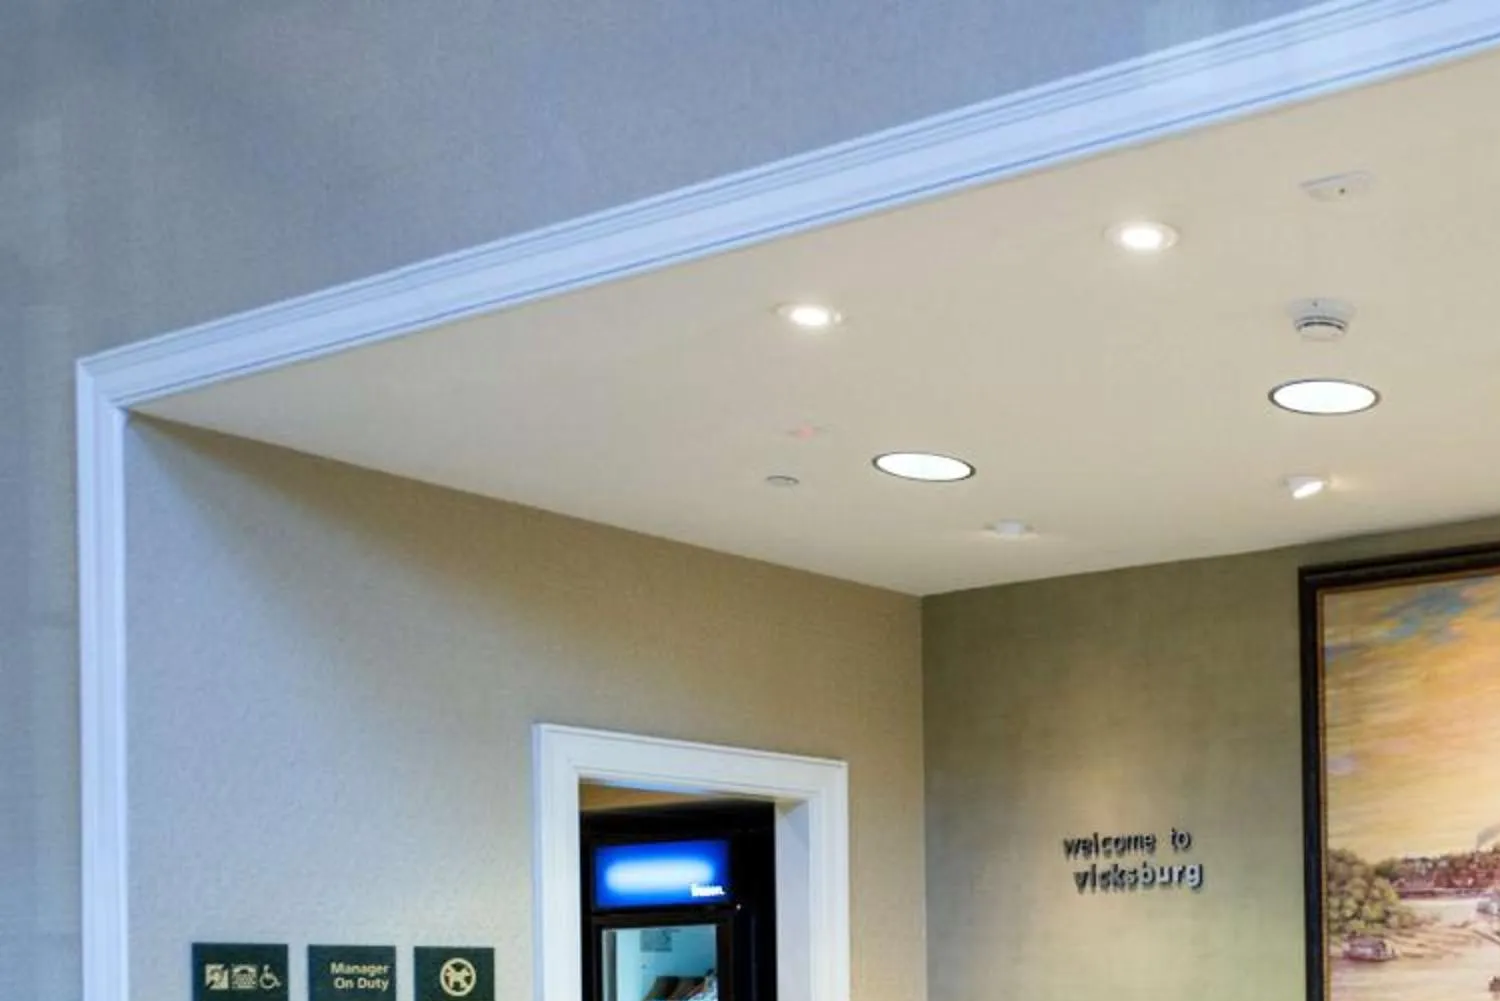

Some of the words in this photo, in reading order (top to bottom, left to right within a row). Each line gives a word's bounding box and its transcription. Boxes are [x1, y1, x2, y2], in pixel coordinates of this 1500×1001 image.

[1063, 832, 1157, 859] welcome
[1170, 827, 1192, 851] to
[1073, 861, 1204, 893] vicksburg
[330, 961, 391, 977] Manager
[334, 977, 355, 990] On
[357, 977, 389, 992] Duty
